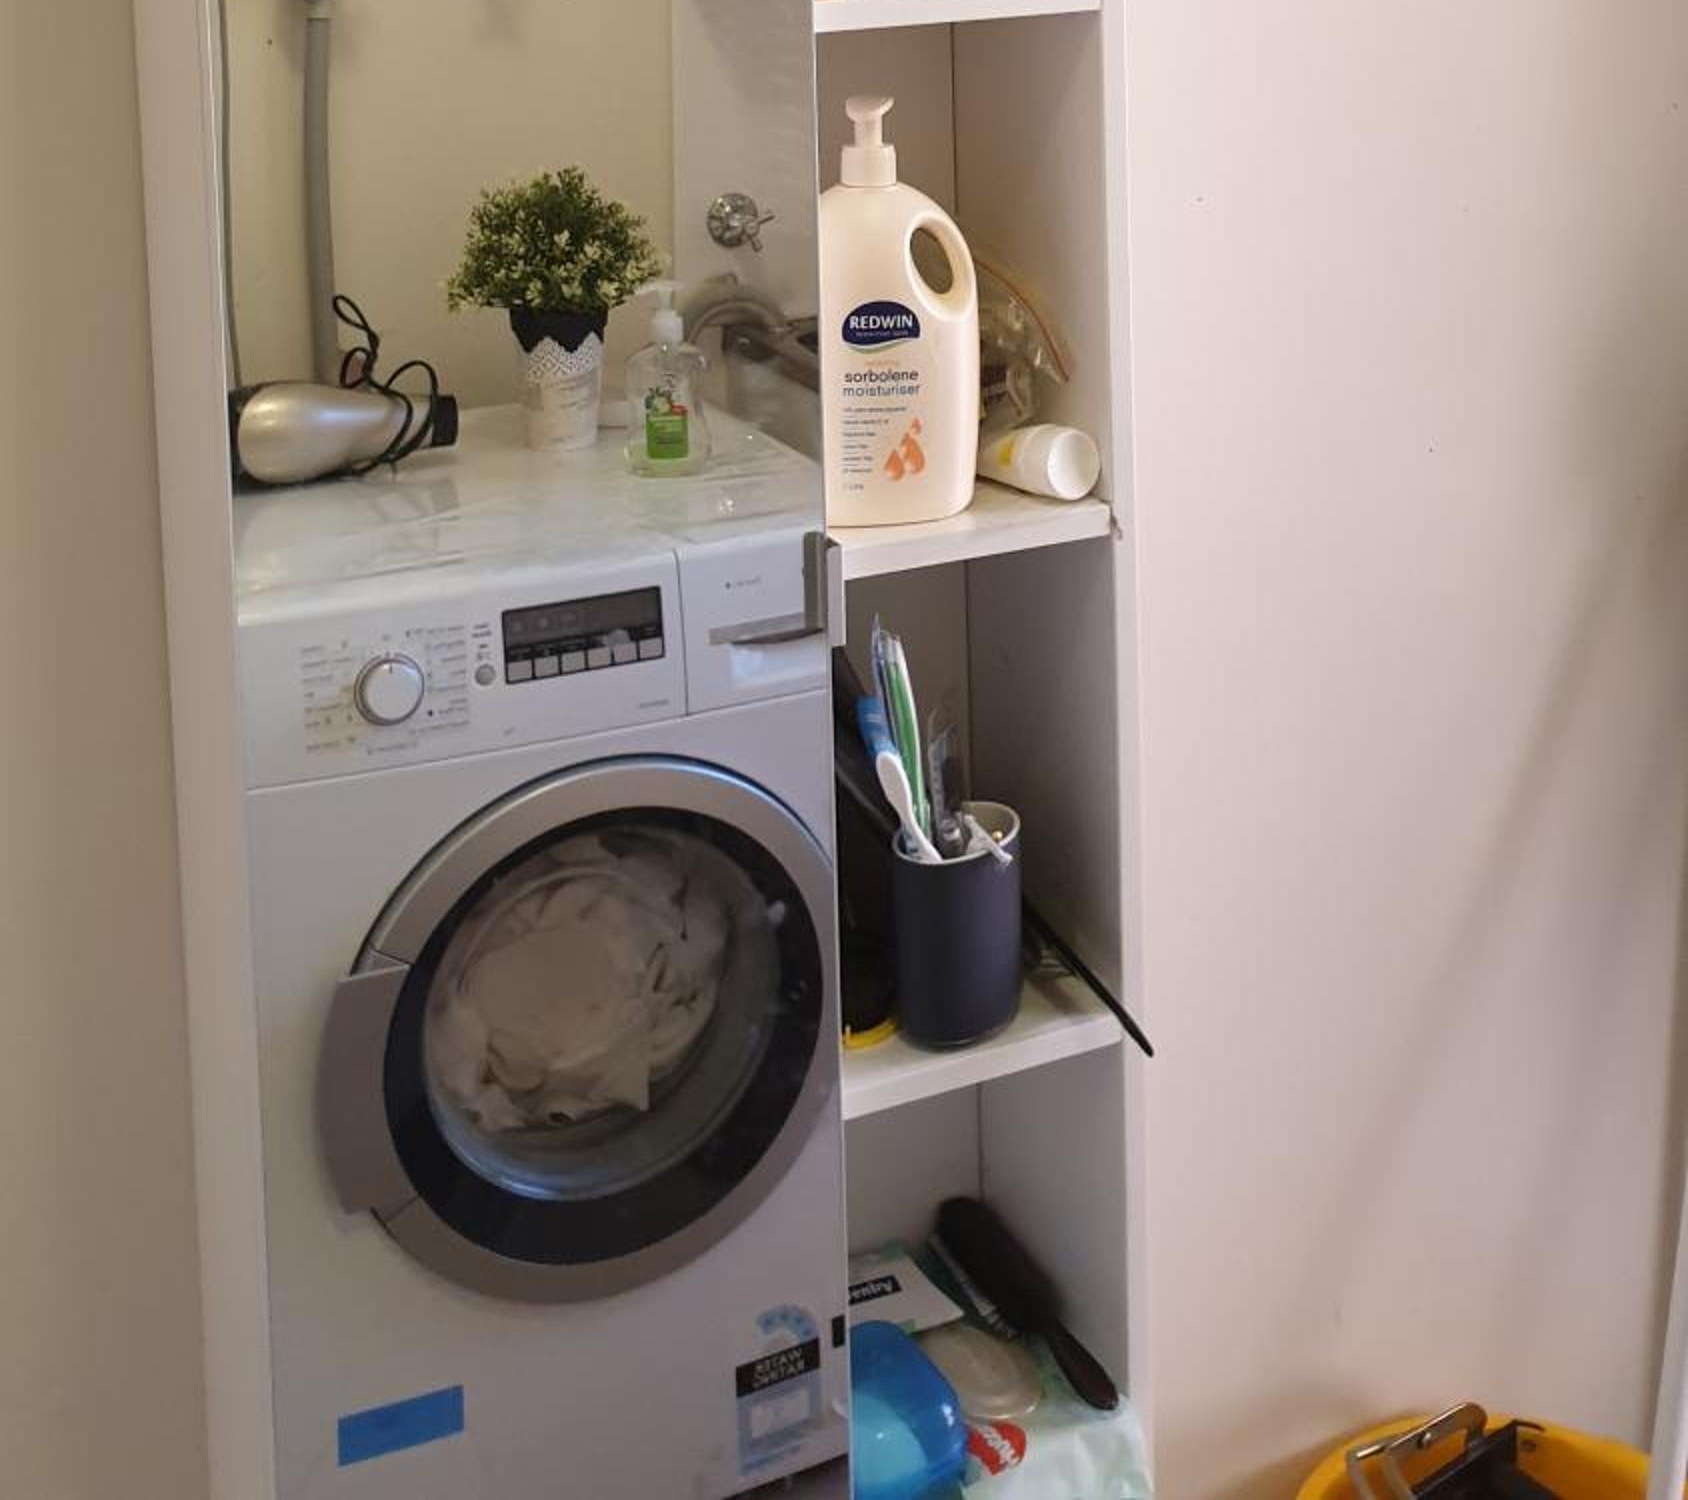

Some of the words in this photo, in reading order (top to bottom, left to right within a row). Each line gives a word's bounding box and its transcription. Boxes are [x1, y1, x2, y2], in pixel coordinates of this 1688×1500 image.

[849, 314, 913, 329] REDWIN
[844, 368, 919, 383] sorbolene
[842, 384, 920, 397] moisturiser
